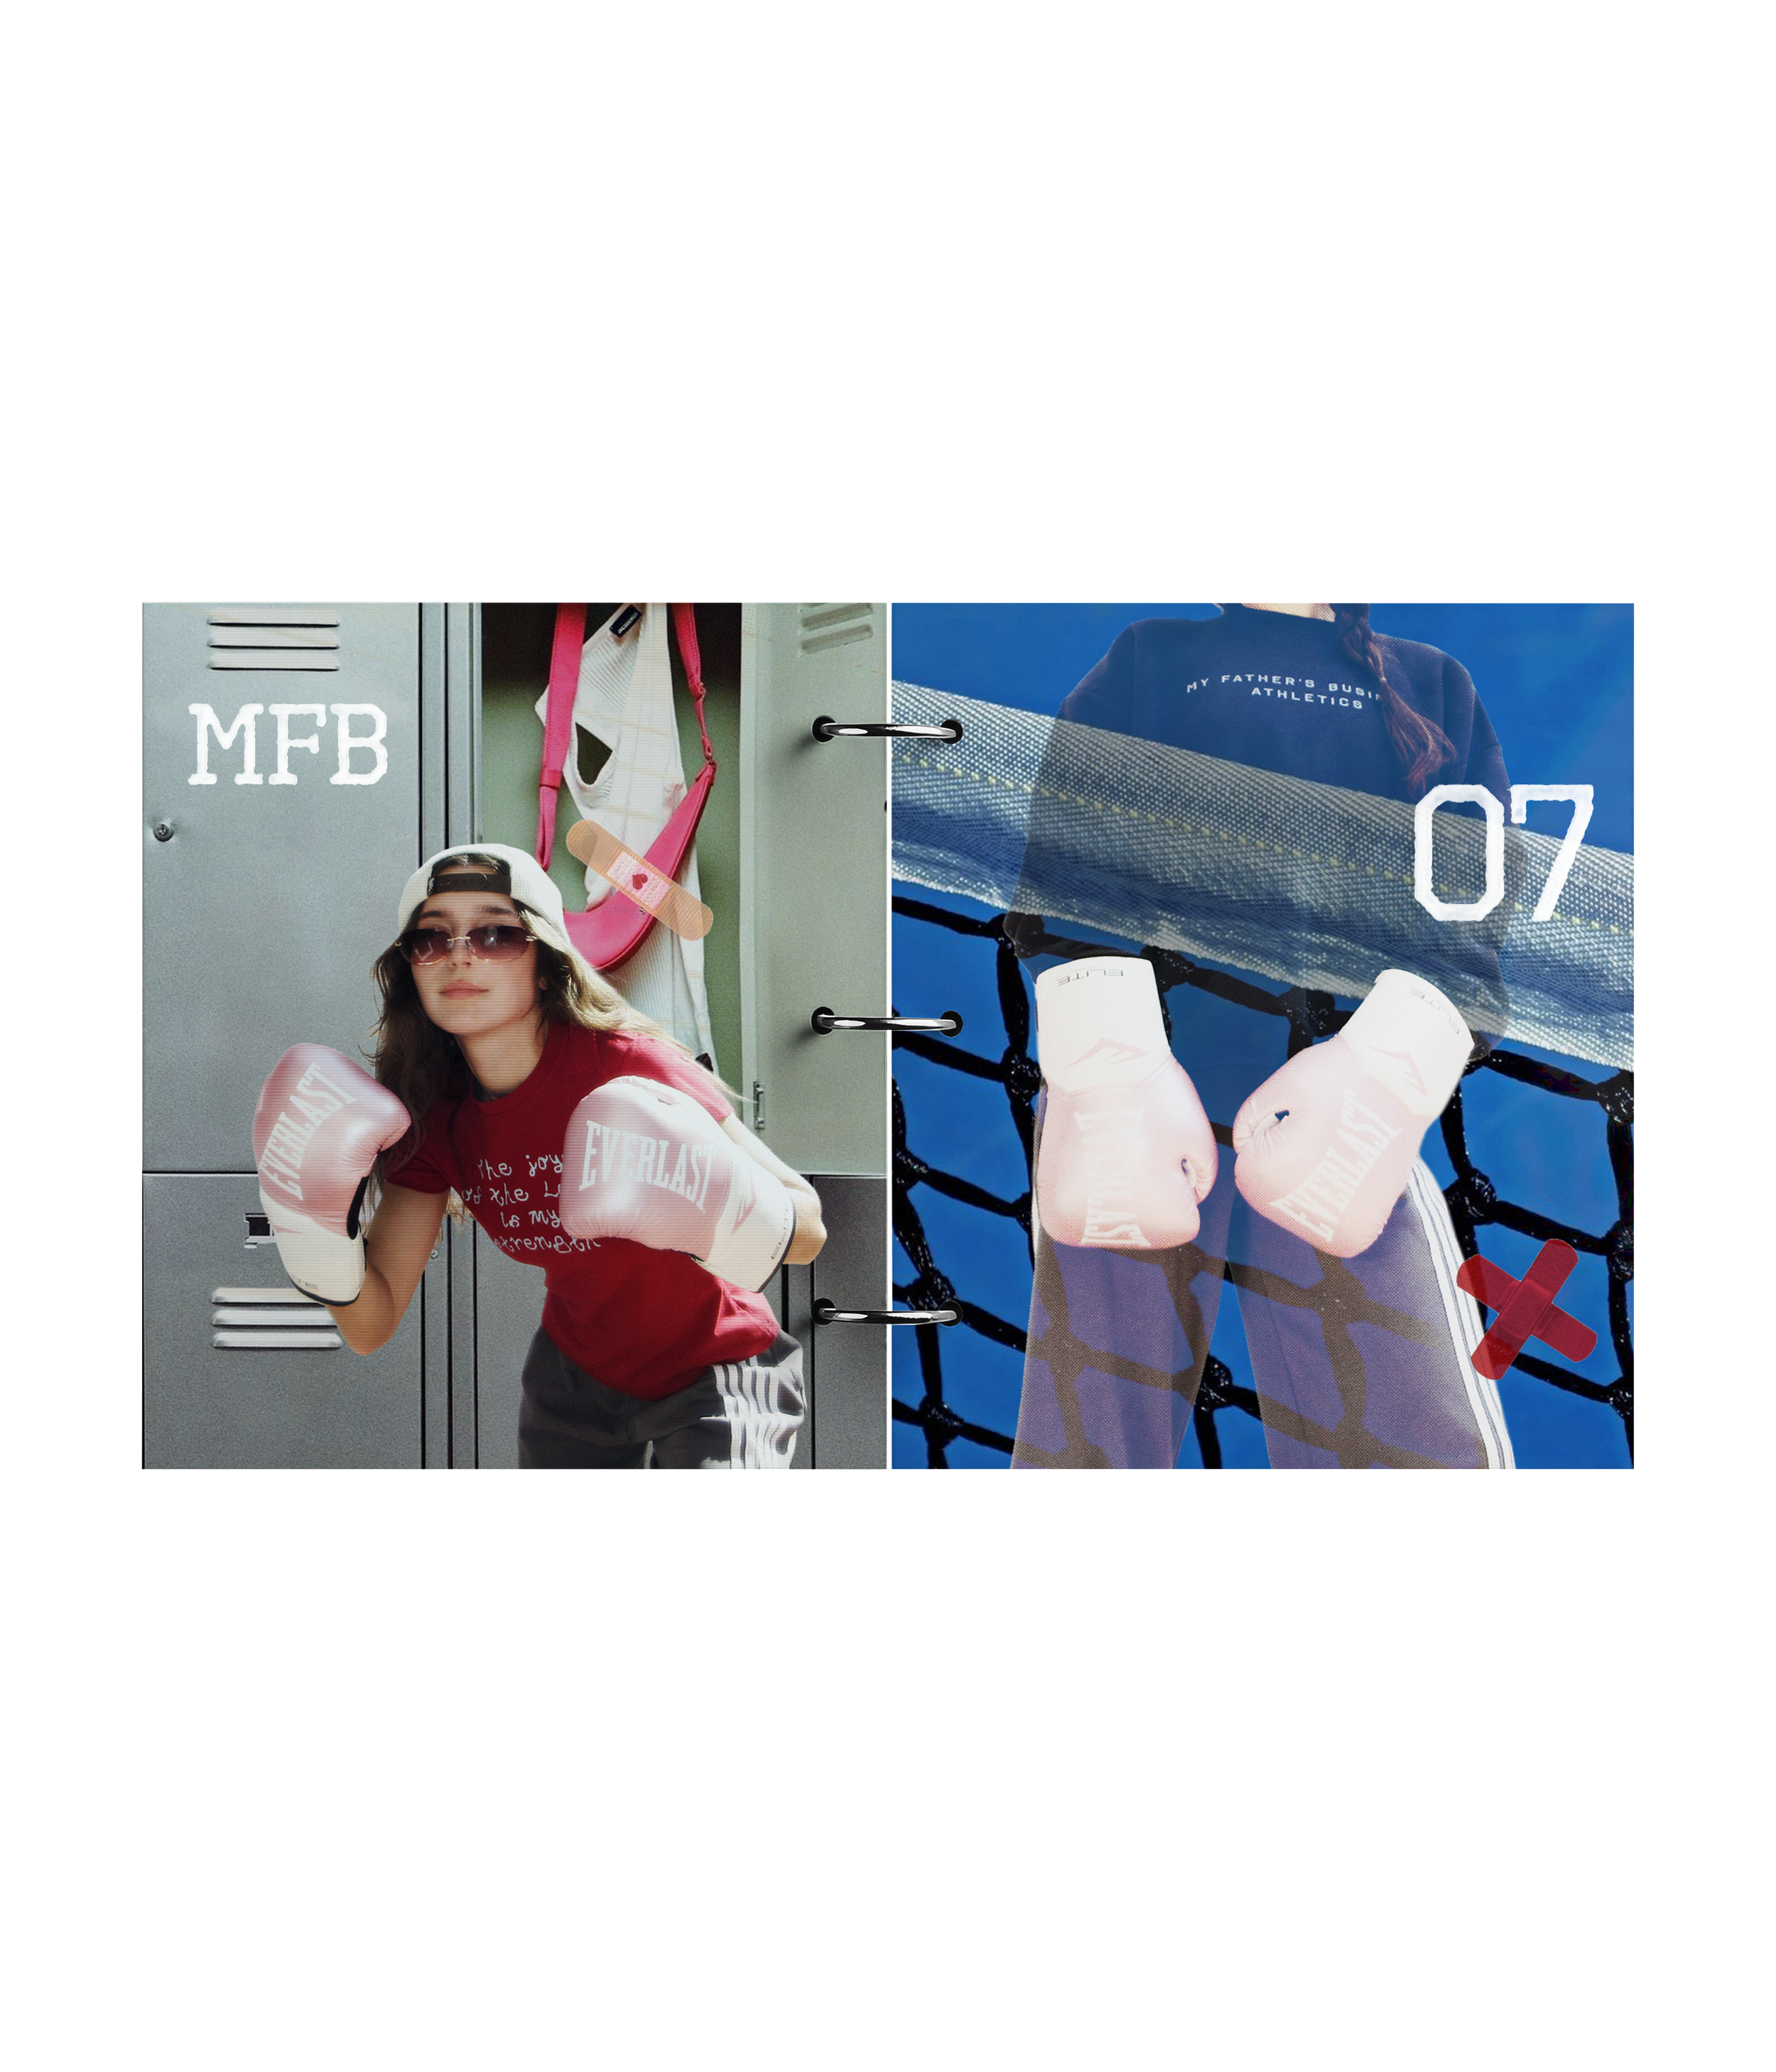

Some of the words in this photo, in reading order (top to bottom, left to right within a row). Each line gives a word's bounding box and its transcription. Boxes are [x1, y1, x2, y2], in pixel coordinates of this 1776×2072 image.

[1186, 678, 1209, 693] MY
[1220, 673, 1315, 688] FATHER'S
[1251, 687, 1363, 710] ATHLETICS
[1056, 968, 1124, 987] ELITE
[1409, 987, 1461, 1035] ELITE
[259, 1062, 359, 1201] EVERLAST
[525, 1154, 563, 1177] joy
[578, 1119, 718, 1215] EVERLAST
[1269, 1087, 1404, 1244] EVERLAST
[461, 1186, 482, 1204] of
[489, 1182, 530, 1206] the
[528, 1209, 561, 1228] my
